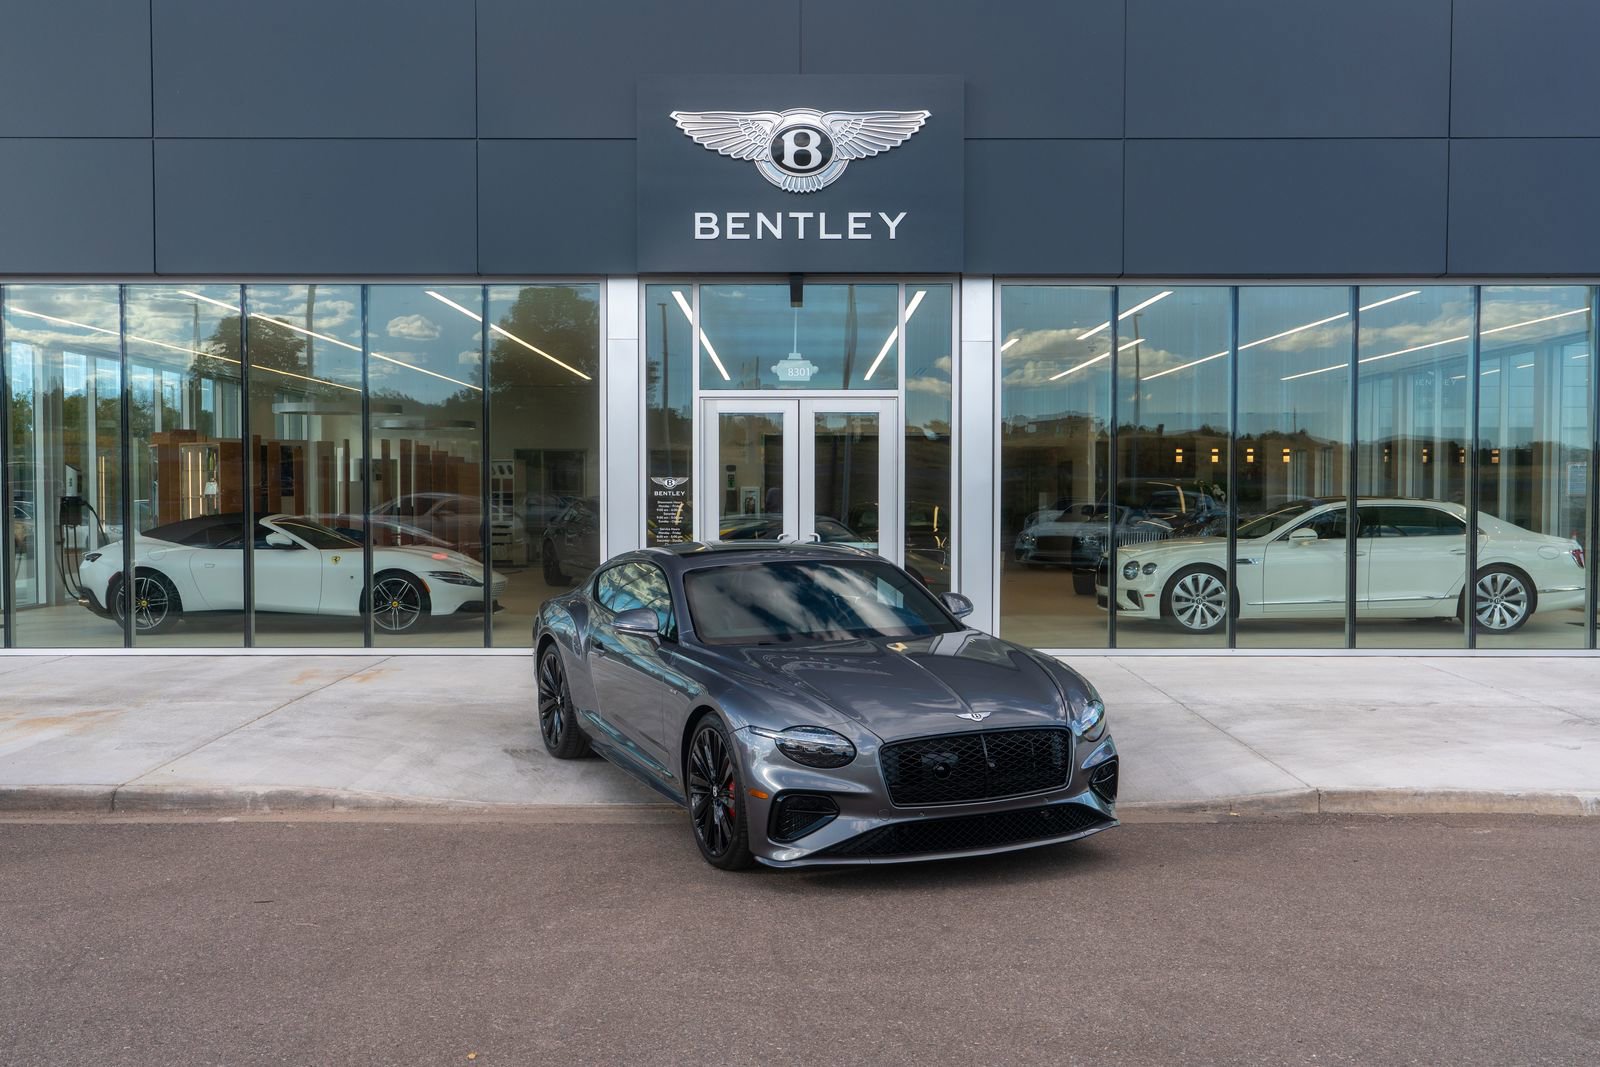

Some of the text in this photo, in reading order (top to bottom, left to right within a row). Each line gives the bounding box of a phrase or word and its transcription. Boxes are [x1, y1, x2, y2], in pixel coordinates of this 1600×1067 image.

[783, 128, 822, 170] B
[694, 212, 908, 240] BENTLEY
[787, 367, 810, 377] 8301
